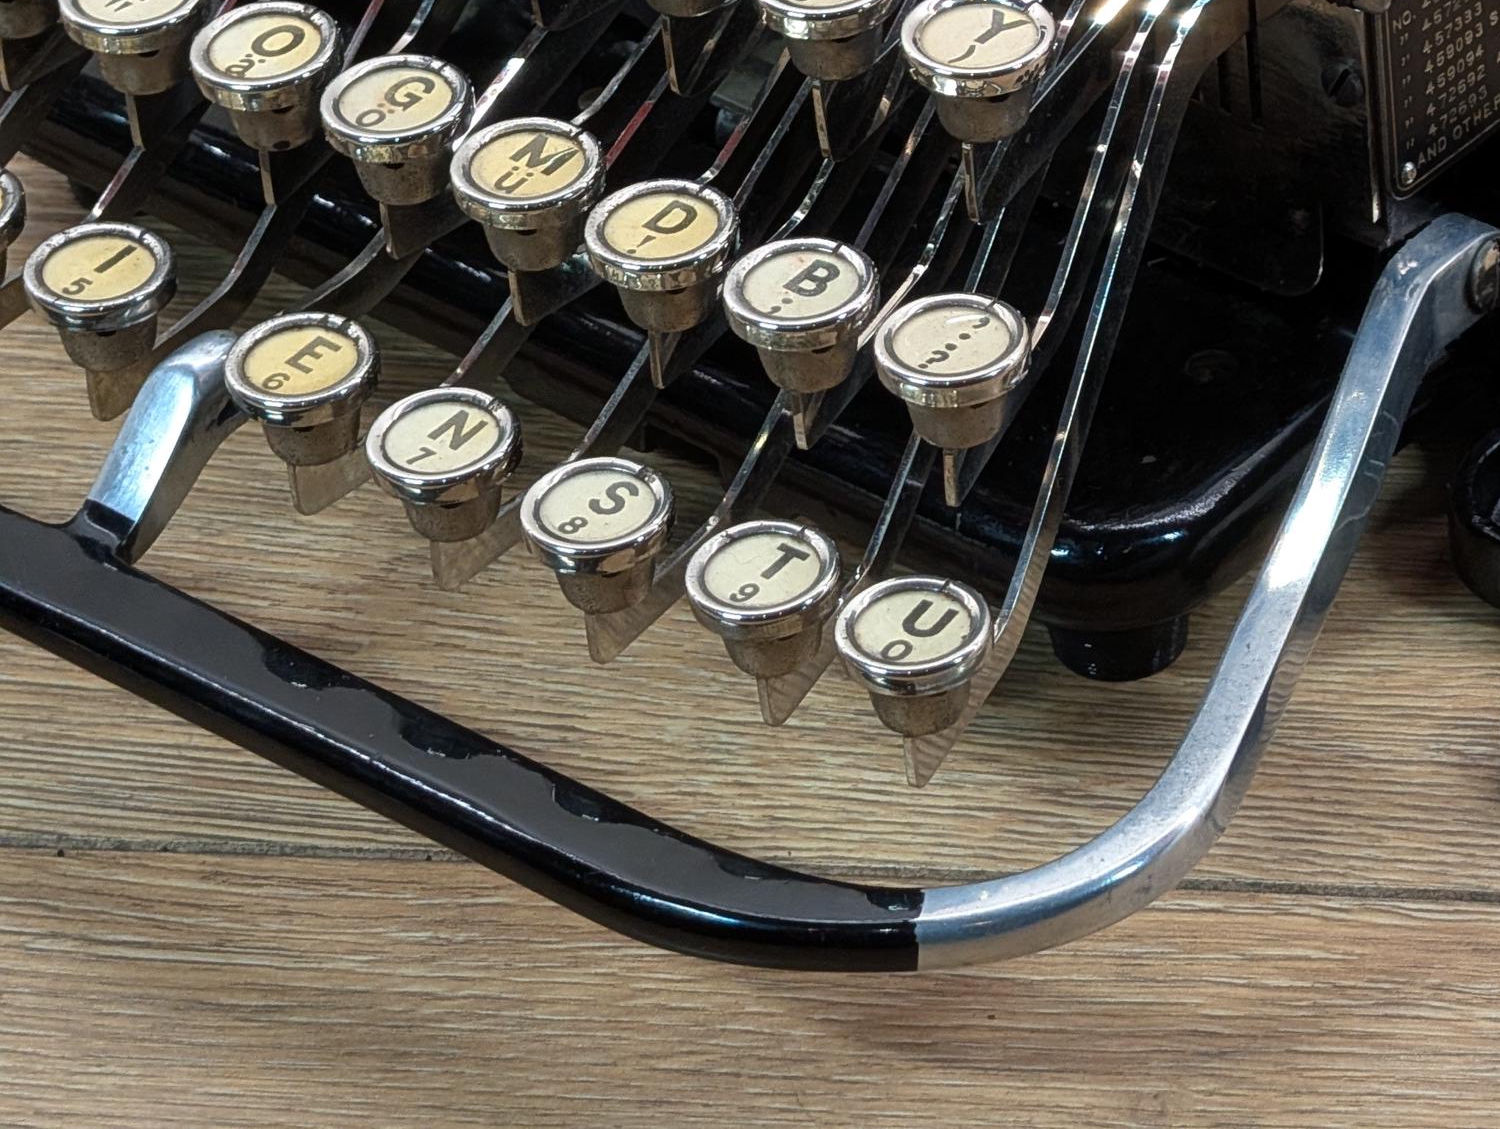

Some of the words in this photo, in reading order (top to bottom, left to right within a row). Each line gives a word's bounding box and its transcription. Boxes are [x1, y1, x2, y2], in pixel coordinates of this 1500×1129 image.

[251, 25, 306, 57] O
[974, 9, 1032, 44] Y
[384, 76, 436, 109] G
[510, 133, 579, 176] M
[1416, 135, 1447, 168] AND
[494, 166, 534, 194] ü
[641, 200, 697, 235] D
[62, 277, 93, 296] 5
[782, 259, 840, 297] B
[284, 335, 342, 374] E
[262, 372, 291, 390] 6
[427, 409, 489, 452] N
[589, 482, 640, 515] S
[558, 517, 589, 534] 8
[760, 543, 811, 580] T
[729, 583, 759, 603] 9
[902, 599, 960, 637] U
